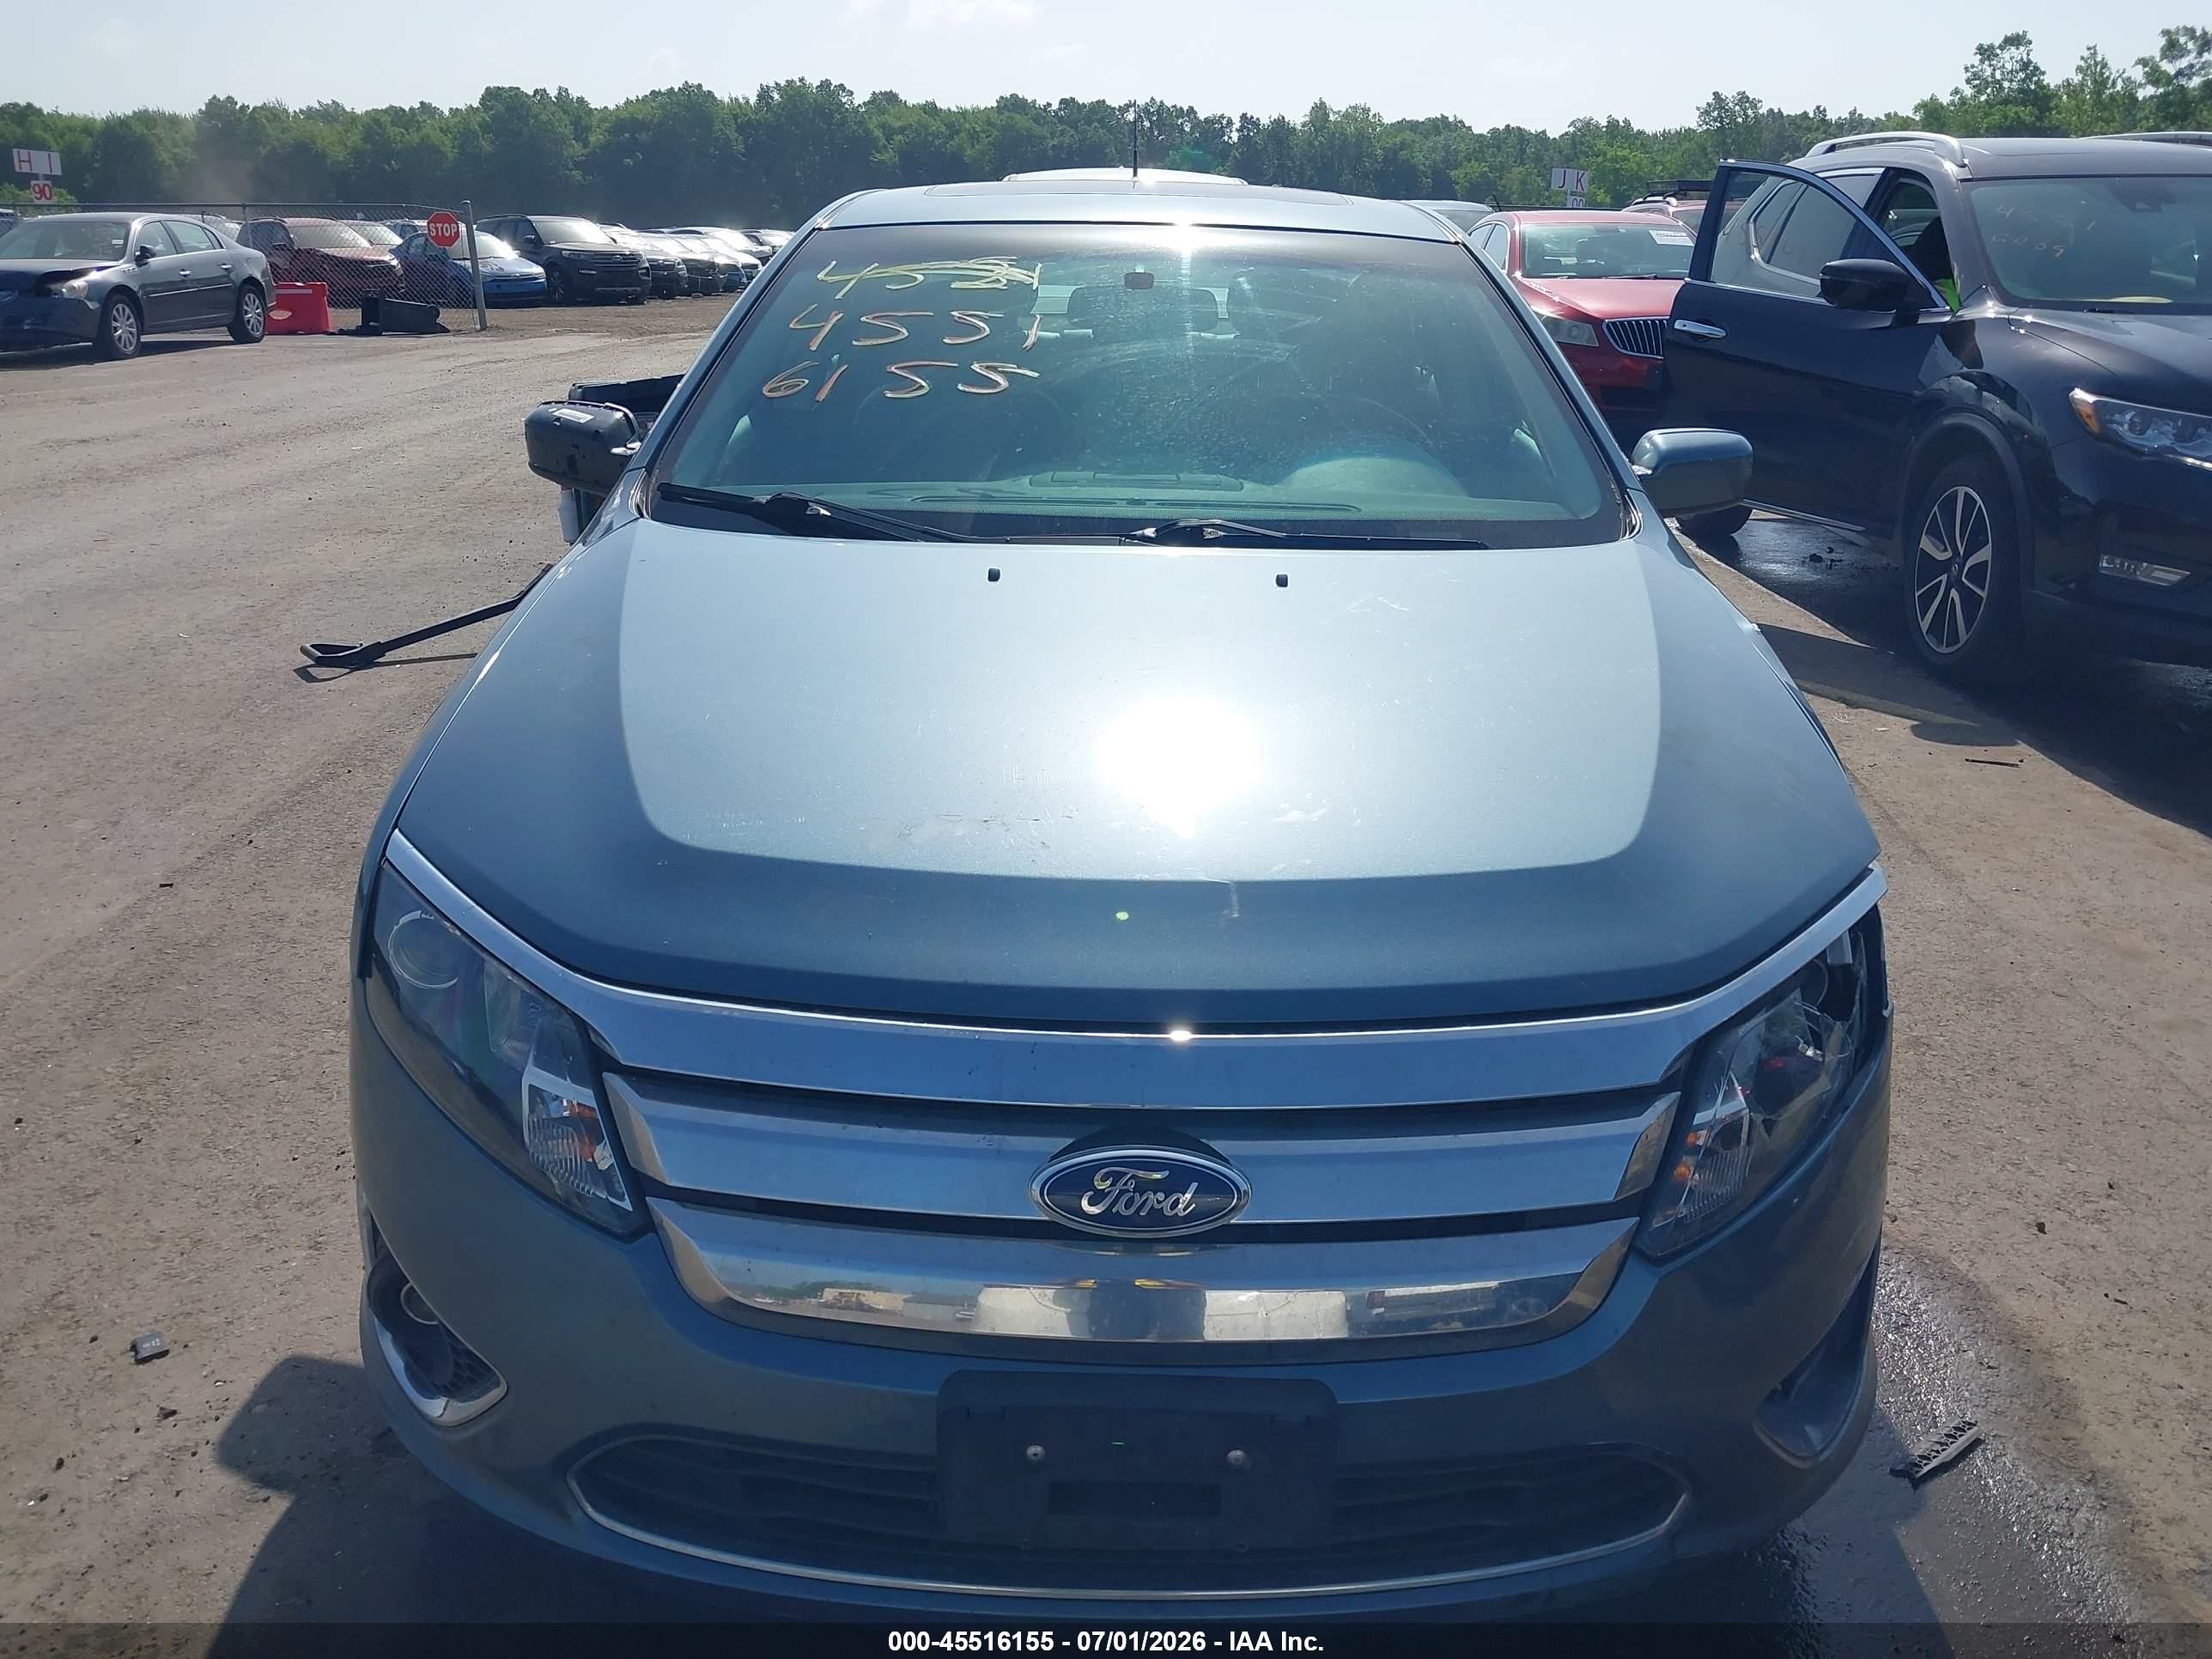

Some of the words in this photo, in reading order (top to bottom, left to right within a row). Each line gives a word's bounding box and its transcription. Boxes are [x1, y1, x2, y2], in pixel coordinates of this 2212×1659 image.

[1558, 169, 1566, 189] J
[1576, 171, 1586, 192] K
[33, 183, 52, 200] 90
[429, 222, 458, 237] STOP
[1081, 1166, 1199, 1217] Ford
